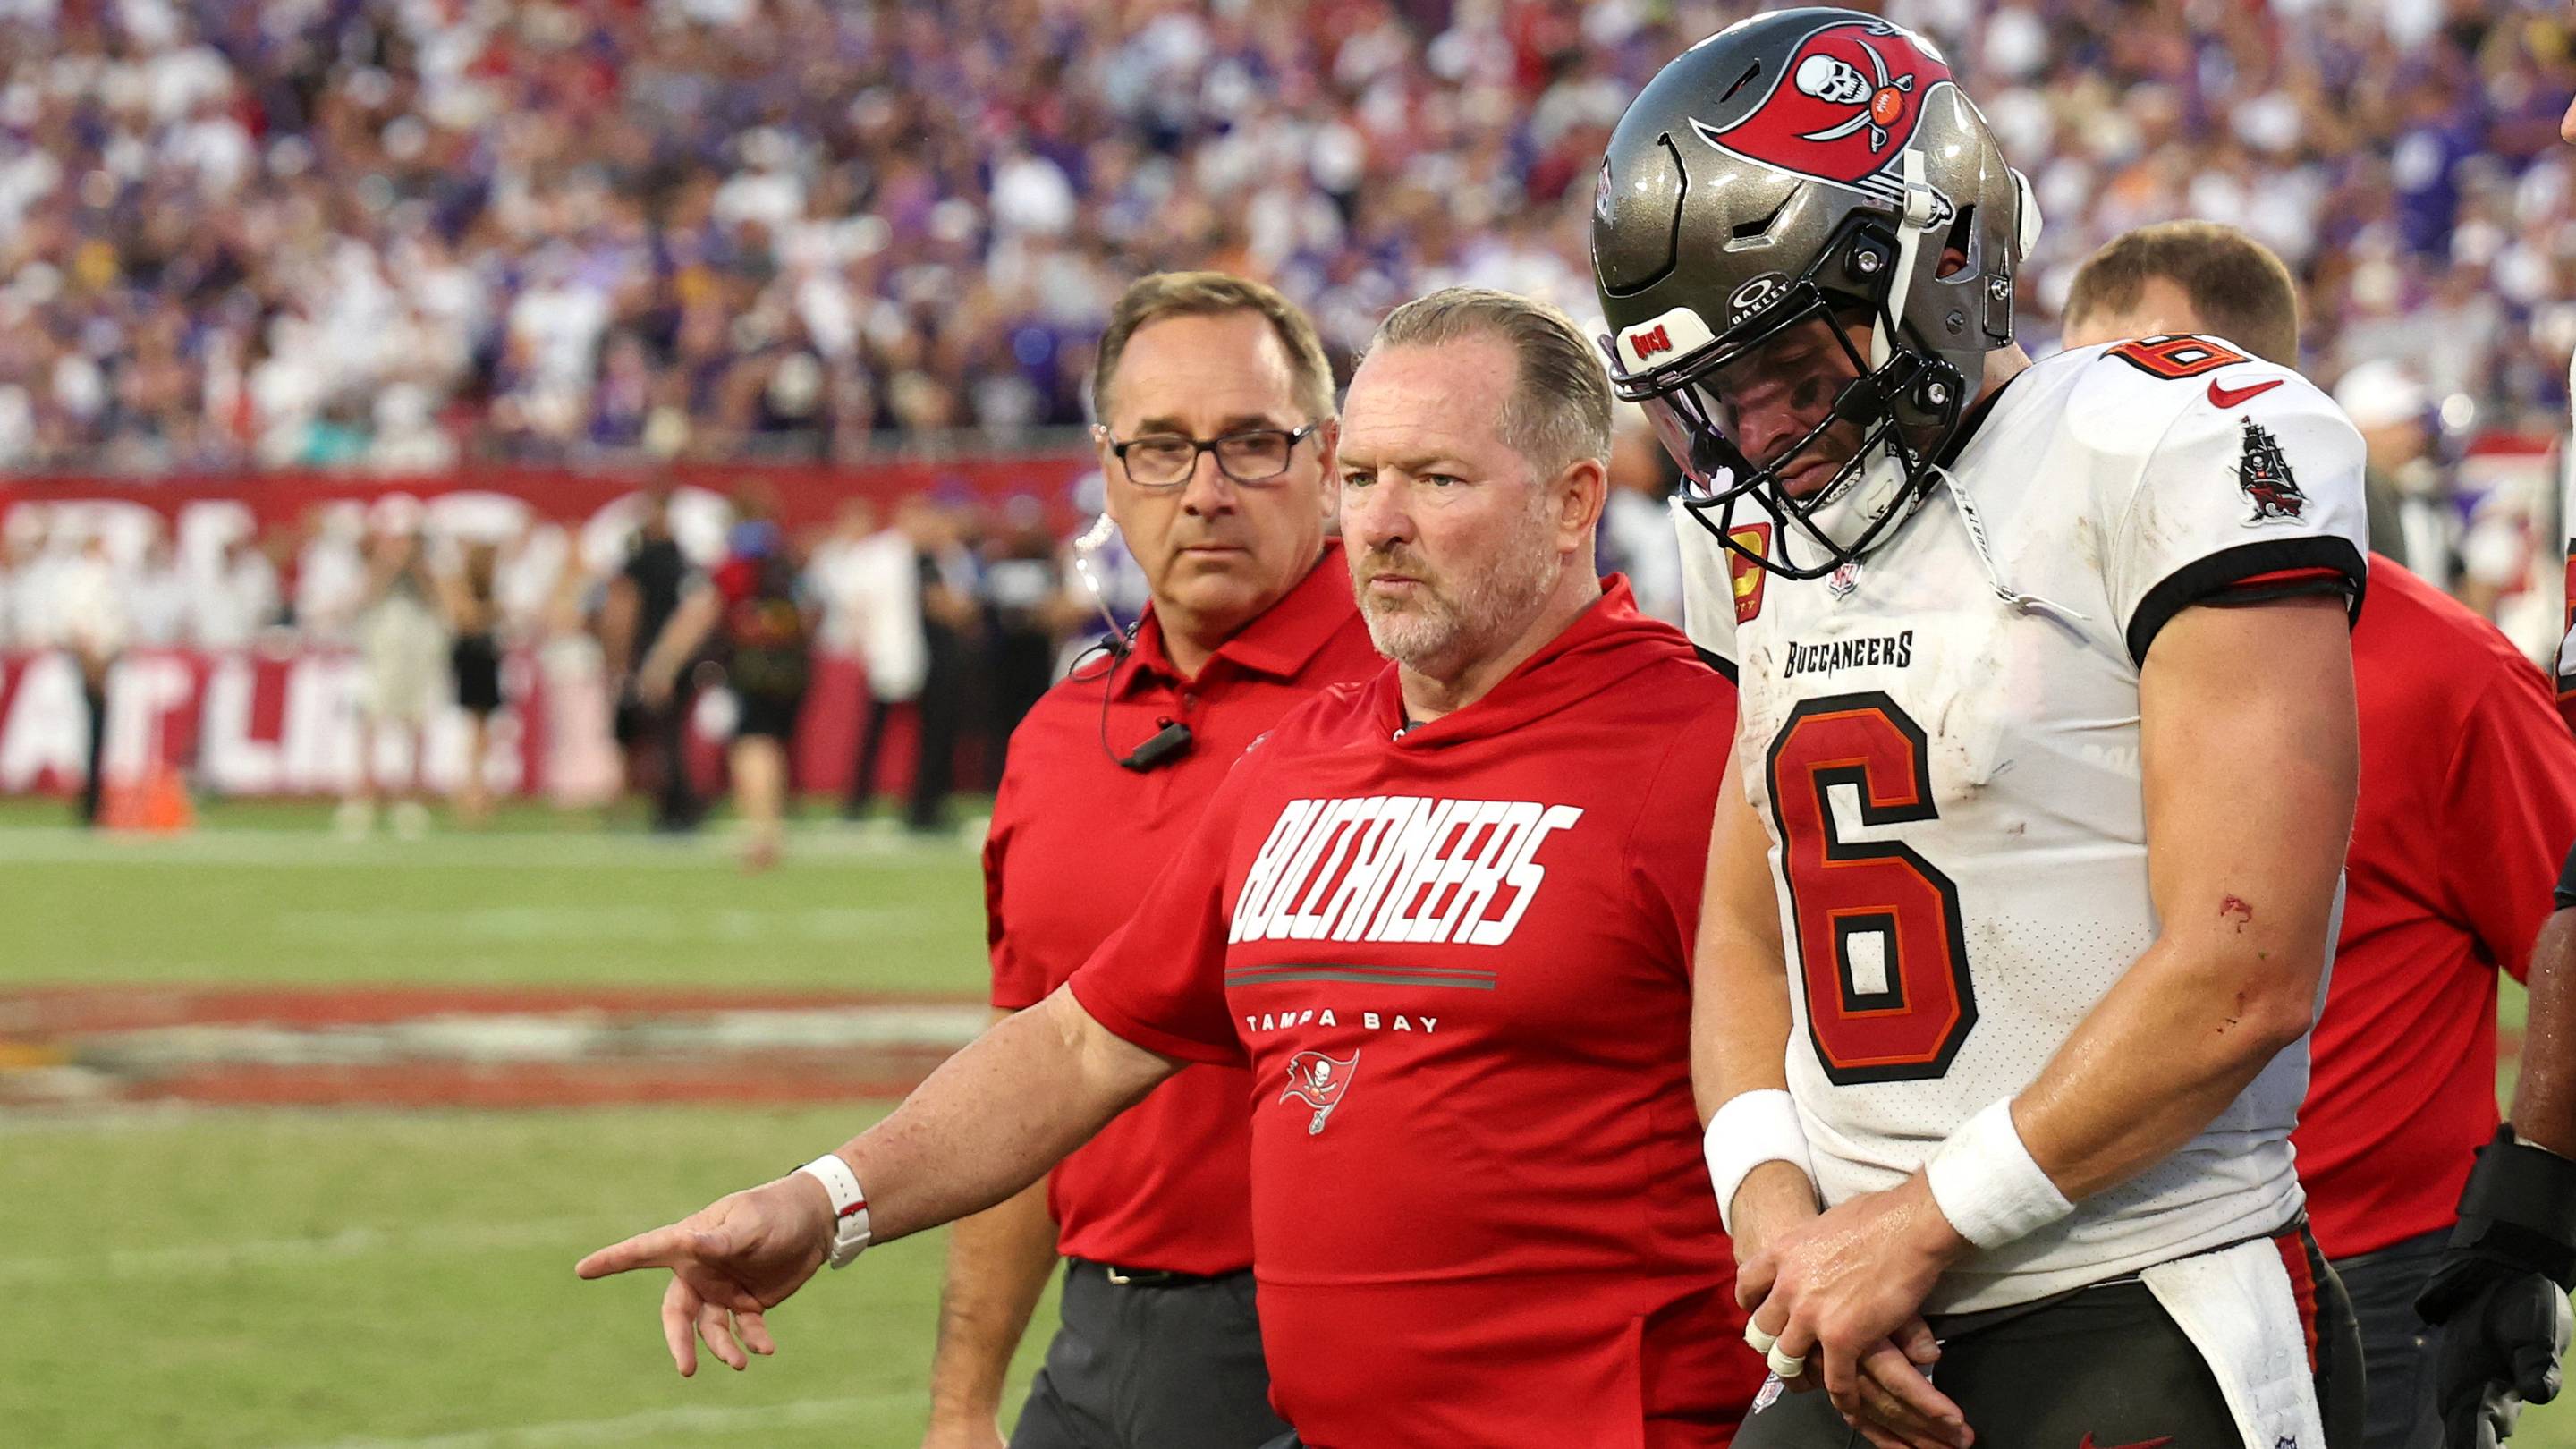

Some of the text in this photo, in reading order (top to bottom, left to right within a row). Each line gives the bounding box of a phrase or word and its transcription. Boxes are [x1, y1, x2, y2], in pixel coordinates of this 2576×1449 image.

[1731, 283, 1788, 325] OAKLEY
[1784, 630, 1913, 679] BUCCANEERS
[1227, 795, 1585, 946] BUCCANEERS
[1766, 691, 1979, 1086] 6
[1246, 1008, 1437, 1033] TAMPA BAY
